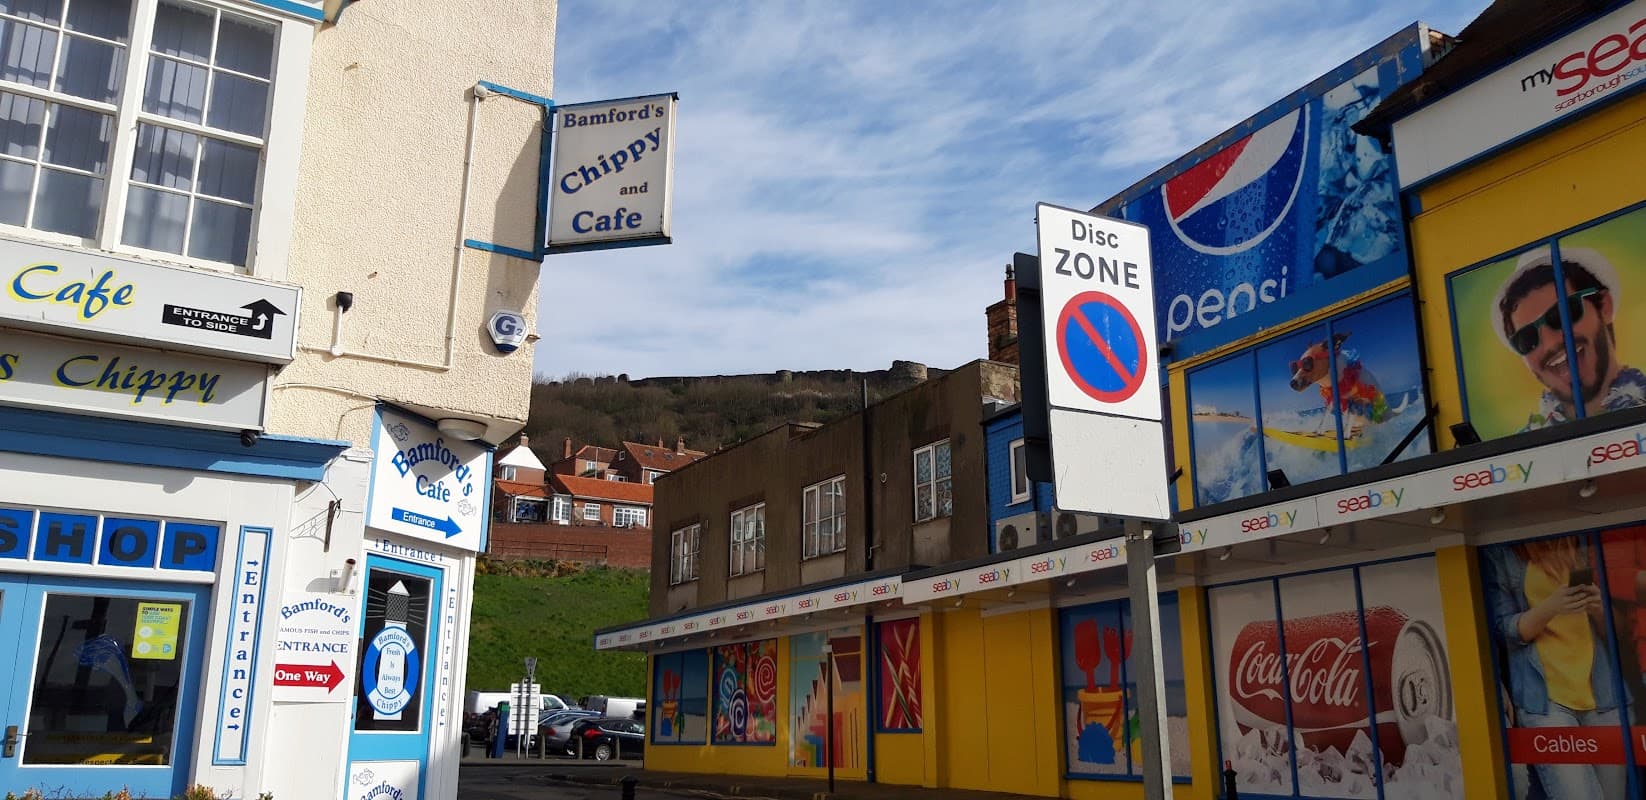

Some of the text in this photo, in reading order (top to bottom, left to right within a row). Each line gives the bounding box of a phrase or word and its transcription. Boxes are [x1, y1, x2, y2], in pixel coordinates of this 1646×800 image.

[563, 104, 664, 128] Bamford's
[560, 127, 661, 195] Chippy
[620, 182, 648, 196] and
[572, 208, 642, 234] Cafe
[1071, 219, 1119, 249] Disc
[1055, 247, 1140, 290] ZONE
[10, 264, 134, 319] Cafe
[173, 307, 249, 326] ENTRANCE
[183, 317, 237, 333] TO SIDE
[56, 355, 221, 403] Chippy
[392, 437, 473, 497] Bamford's
[1453, 460, 1533, 492] seabay
[415, 474, 450, 503] Cafe
[1337, 487, 1404, 514] seabay
[403, 509, 435, 528] Entrance
[1241, 509, 1297, 533] seabay
[383, 539, 436, 562] Entrance
[1031, 556, 1066, 574] seabay
[281, 598, 350, 624] Bamford's
[229, 571, 258, 718] Entrance
[378, 632, 410, 648] Bamford's
[440, 597, 456, 717] Entrance
[275, 670, 331, 684] One Way
[384, 686, 396, 694] Best
[376, 698, 402, 711] Chippy
[1534, 735, 1598, 753] Cables
